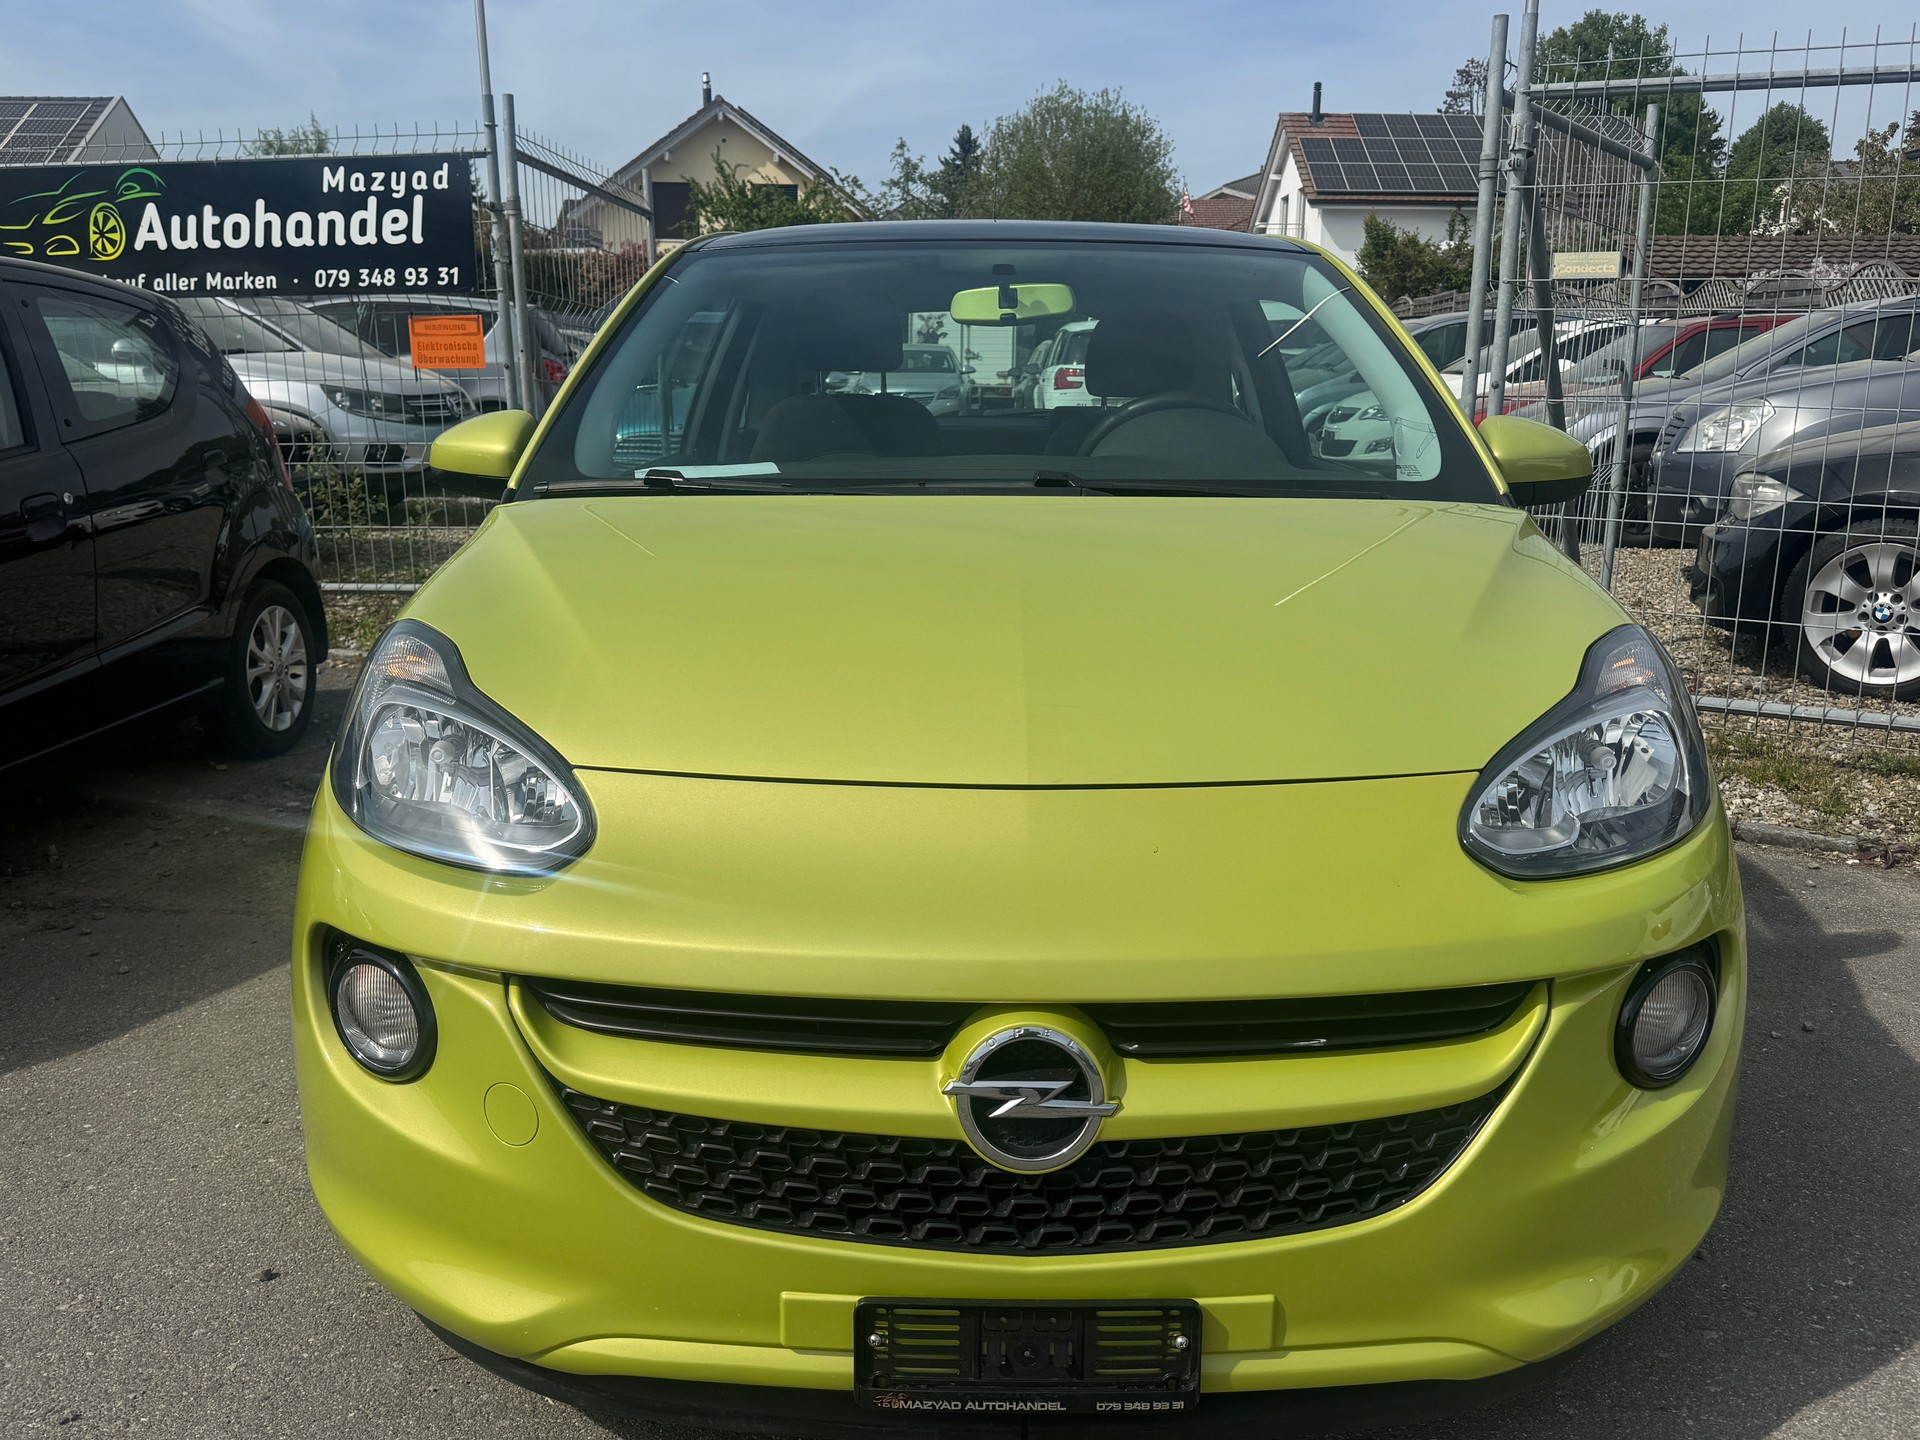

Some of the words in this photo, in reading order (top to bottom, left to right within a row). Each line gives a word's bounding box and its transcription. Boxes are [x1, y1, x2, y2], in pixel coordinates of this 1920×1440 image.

[322, 162, 449, 199] Mazyad
[134, 194, 424, 251] Autohandel
[1556, 264, 1617, 274] Condecta
[153, 272, 198, 291] aller
[206, 271, 277, 291] Marken
[314, 269, 351, 288] 079
[358, 268, 396, 287] 348
[404, 267, 429, 286] 93
[437, 266, 459, 286] 31
[424, 323, 467, 331] WARNUNG
[417, 341, 478, 351] Elektronische
[417, 352, 480, 365] Überwachung!
[986, 1028, 1075, 1049] OPEL
[900, 1400, 962, 1410] MAZYAD
[965, 1401, 1067, 1411] AUTOHANDEL
[1096, 1401, 1122, 1411] 079
[1124, 1401, 1150, 1411] 348
[1152, 1401, 1170, 1410] 93
[1172, 1400, 1185, 1410] 31
